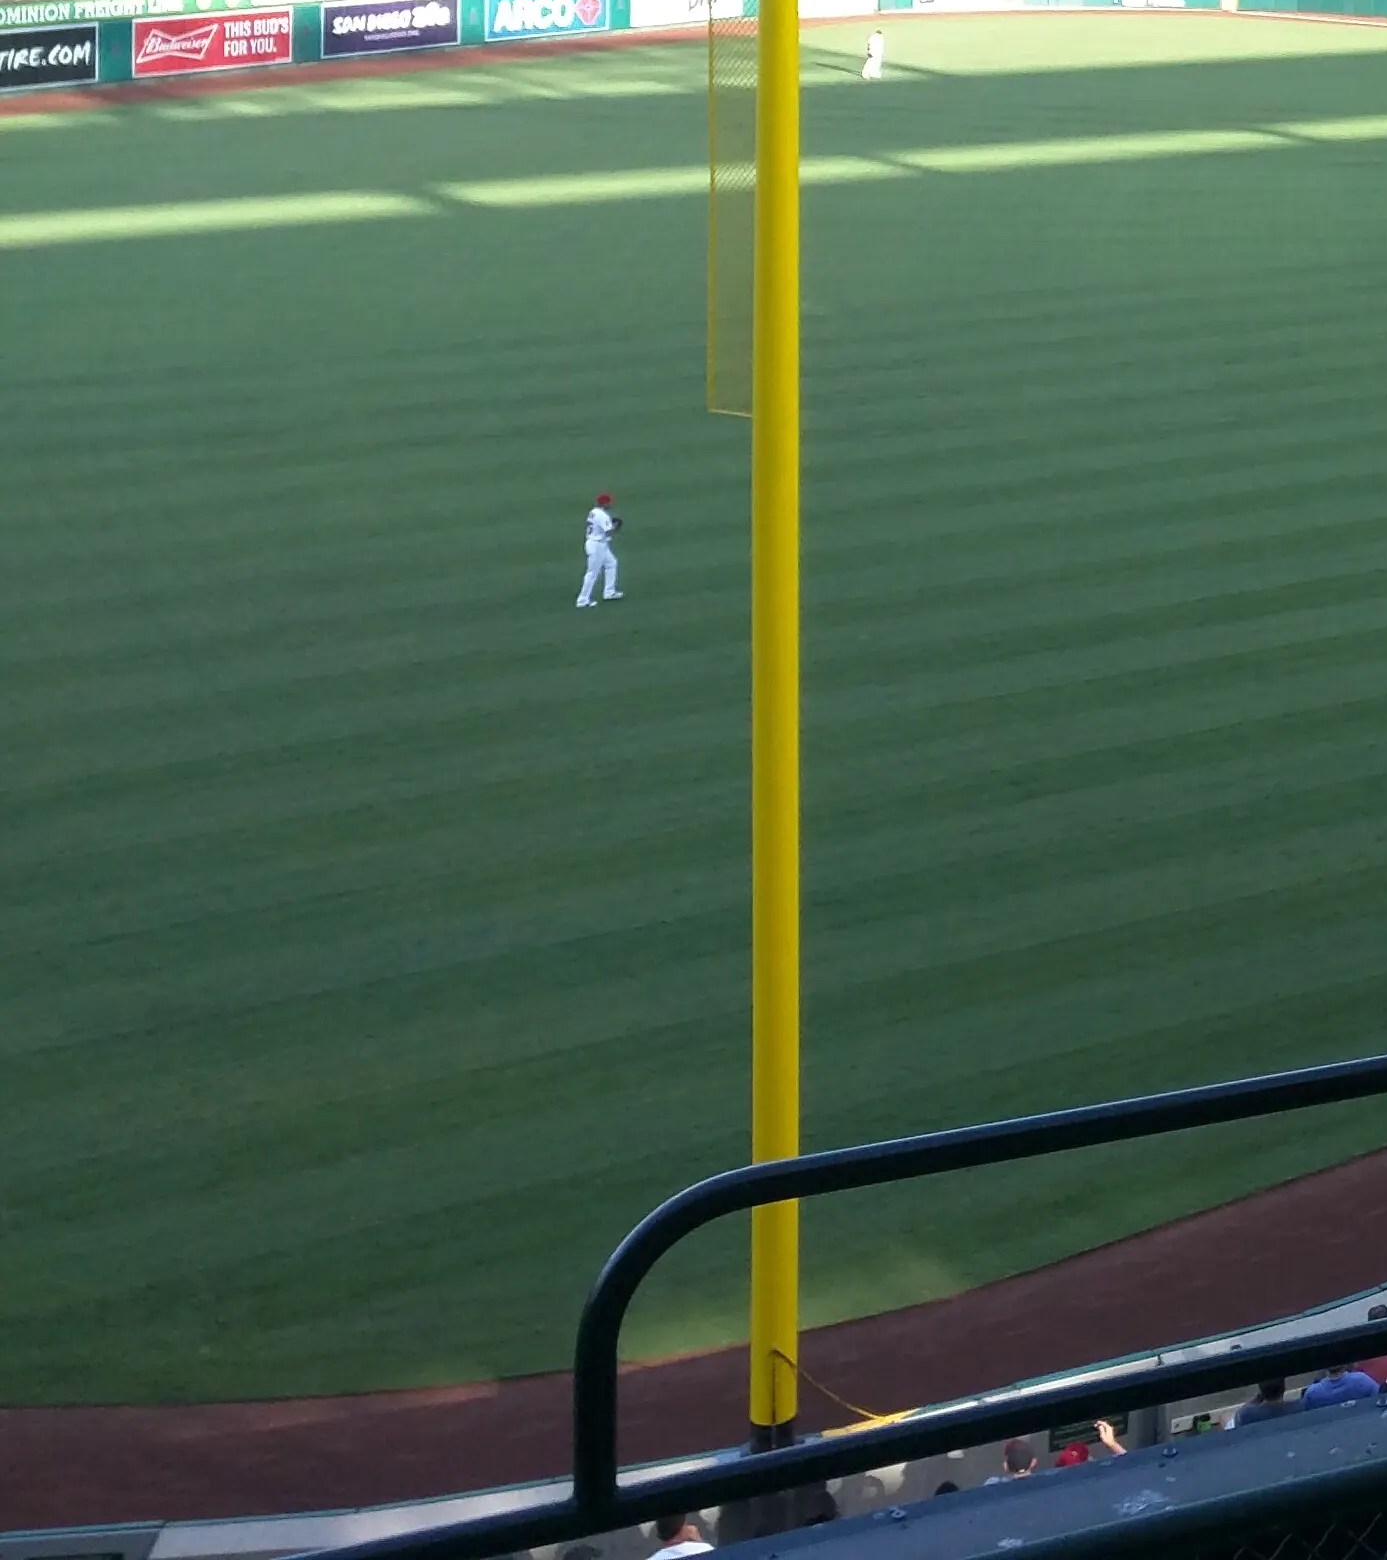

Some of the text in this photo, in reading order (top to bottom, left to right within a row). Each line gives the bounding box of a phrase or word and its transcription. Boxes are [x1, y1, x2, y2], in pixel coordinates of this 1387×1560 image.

[223, 16, 289, 39] THIS BUD'S
[332, 14, 366, 35] SAN
[0, 40, 92, 71] TIRE.COM
[145, 36, 211, 54] Budweiser
[223, 37, 277, 57] FOR YOU.
